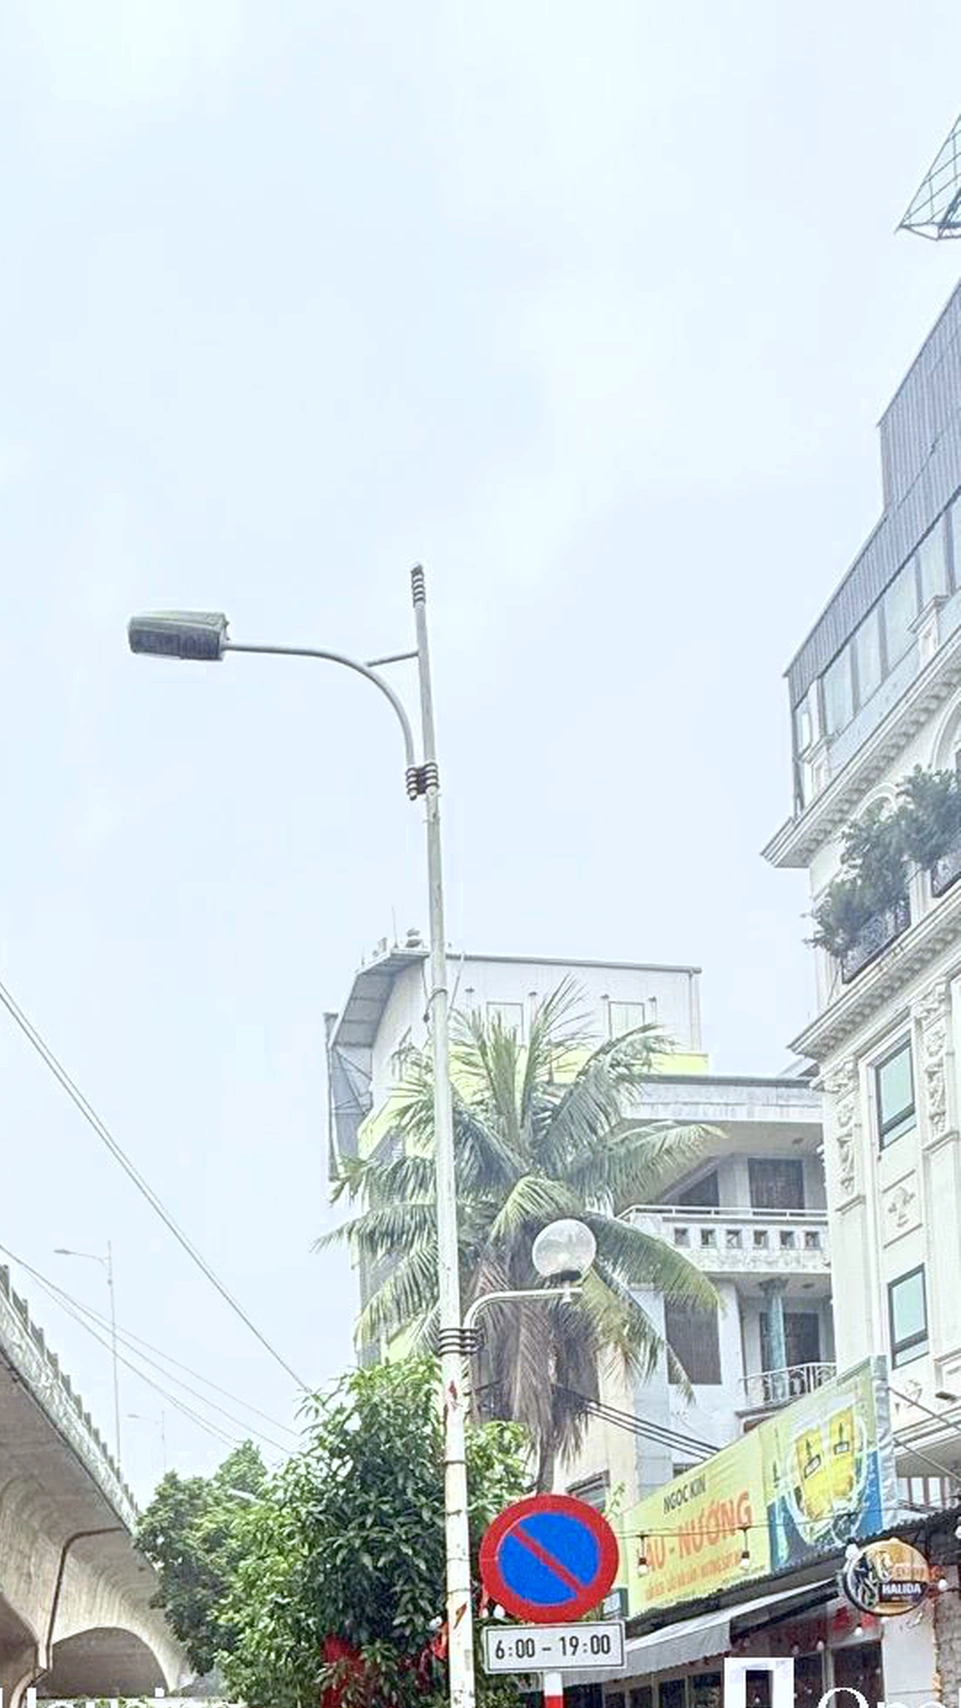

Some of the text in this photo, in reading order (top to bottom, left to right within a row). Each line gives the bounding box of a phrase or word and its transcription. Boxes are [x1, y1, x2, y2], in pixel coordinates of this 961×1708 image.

[882, 1583, 922, 1595] HALIDA
[495, 1637, 535, 1660] 6:00
[559, 1634, 611, 1657] 19:00
